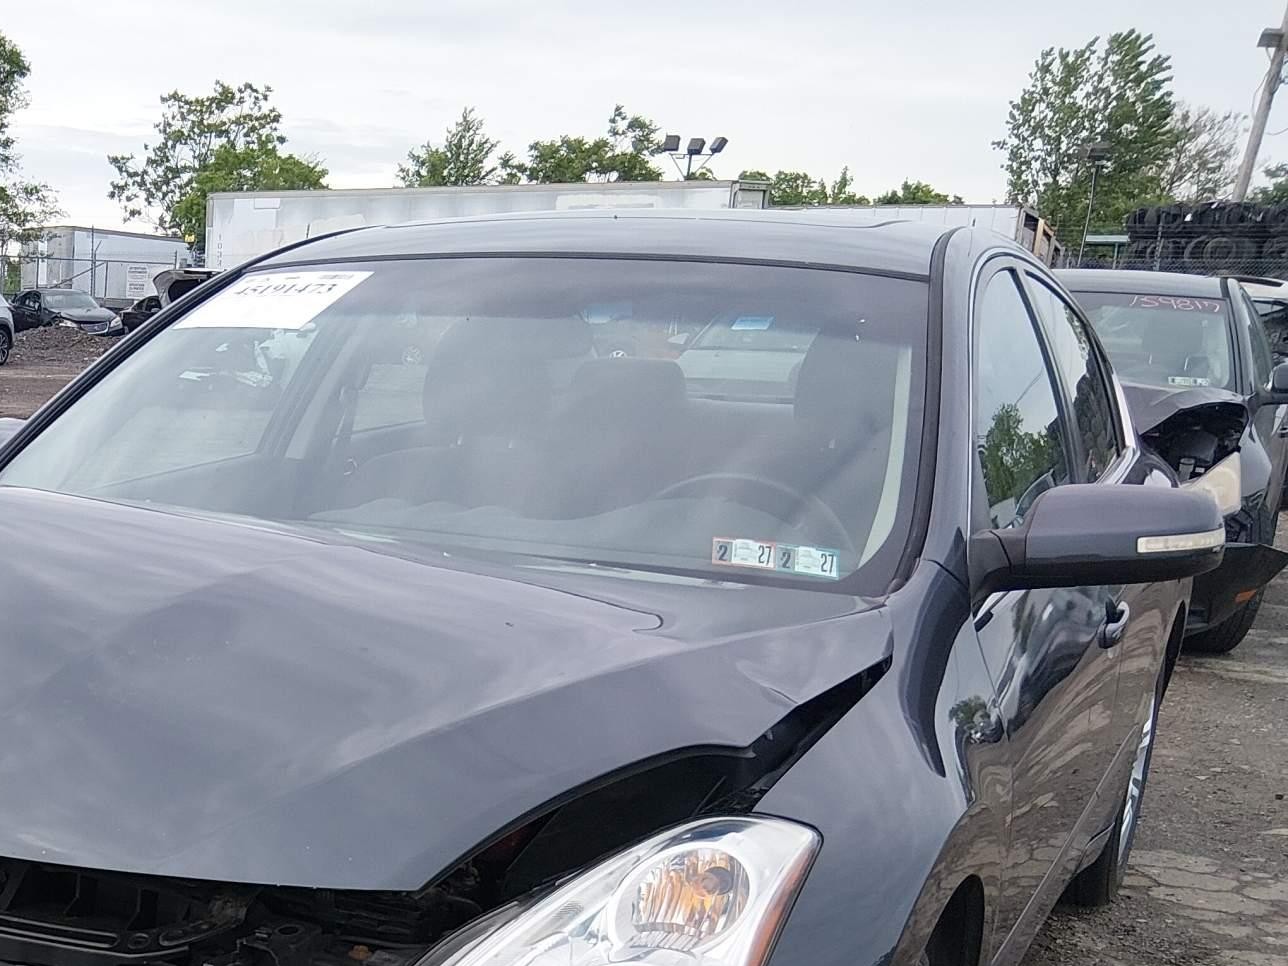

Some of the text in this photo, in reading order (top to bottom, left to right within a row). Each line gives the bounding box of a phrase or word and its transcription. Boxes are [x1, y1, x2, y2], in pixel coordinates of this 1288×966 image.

[717, 544, 772, 566] 2 27
[781, 551, 834, 574] 2 27
